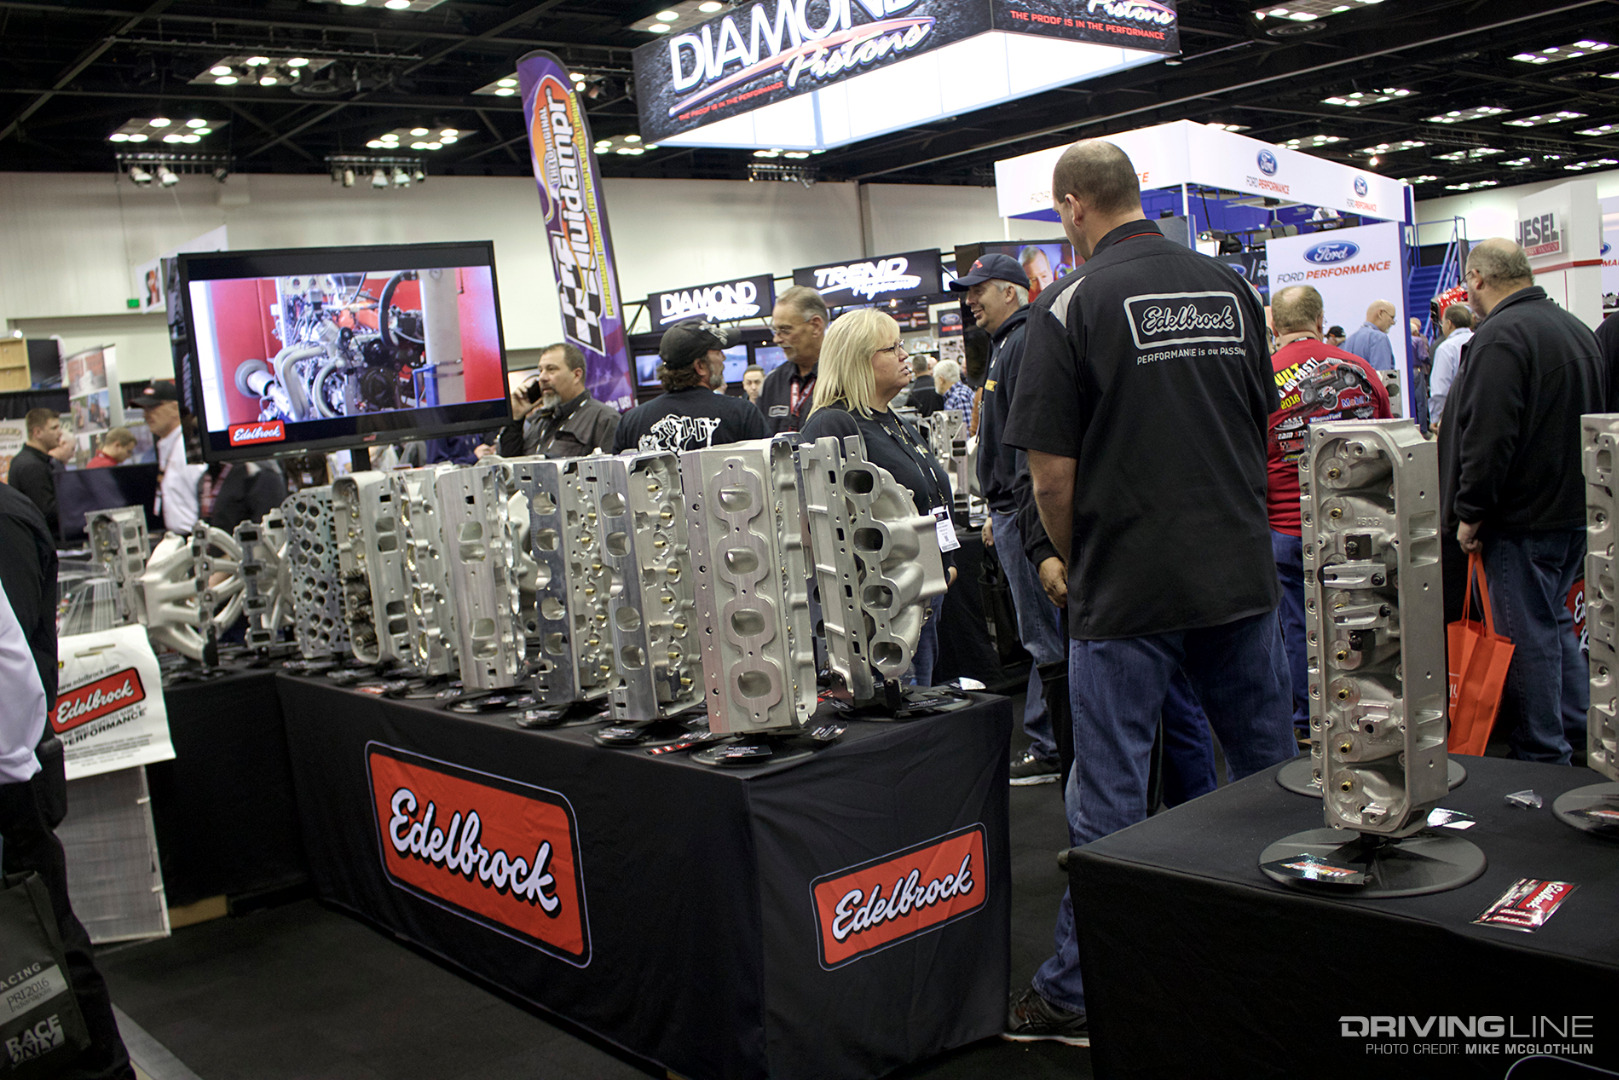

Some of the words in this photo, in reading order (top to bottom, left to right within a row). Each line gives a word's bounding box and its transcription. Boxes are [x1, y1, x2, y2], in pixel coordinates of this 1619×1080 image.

[1010, 10, 1029, 21] THE
[1031, 13, 1062, 25] PROOF
[1064, 17, 1073, 27] IS
[1075, 20, 1086, 29] IN
[1087, 21, 1104, 31] THE
[1105, 25, 1165, 40] PERFORMANCE
[783, 24, 931, 89] Pistons
[678, 112, 690, 121] THE
[690, 106, 711, 117] PROOF
[726, 96, 738, 105] THE
[738, 80, 784, 101] PERFORMANCE
[539, 105, 557, 163] ORIGINAL
[1258, 178, 1290, 195] PERFORMANCE
[590, 211, 604, 252] DAMPERS
[1516, 213, 1559, 248] JESEL
[1314, 244, 1349, 262] Ford
[597, 254, 615, 315] PERFORMANCE
[814, 257, 908, 288] TREND
[1277, 271, 1305, 284] FORD
[1306, 260, 1391, 281] PERFORMANCE
[661, 281, 757, 317] DIAMOND
[1141, 304, 1236, 336] Edelbrock
[1198, 347, 1206, 356] is
[1274, 362, 1300, 387] UILT
[1280, 394, 1301, 410] 2016
[233, 425, 281, 442] Edelbrock
[56, 679, 134, 724] Edelbrock
[389, 788, 560, 915] Edelbrock
[832, 853, 974, 941] Edelbrock
[0, 962, 41, 991] ACING
[5, 1013, 60, 1056] RACE
